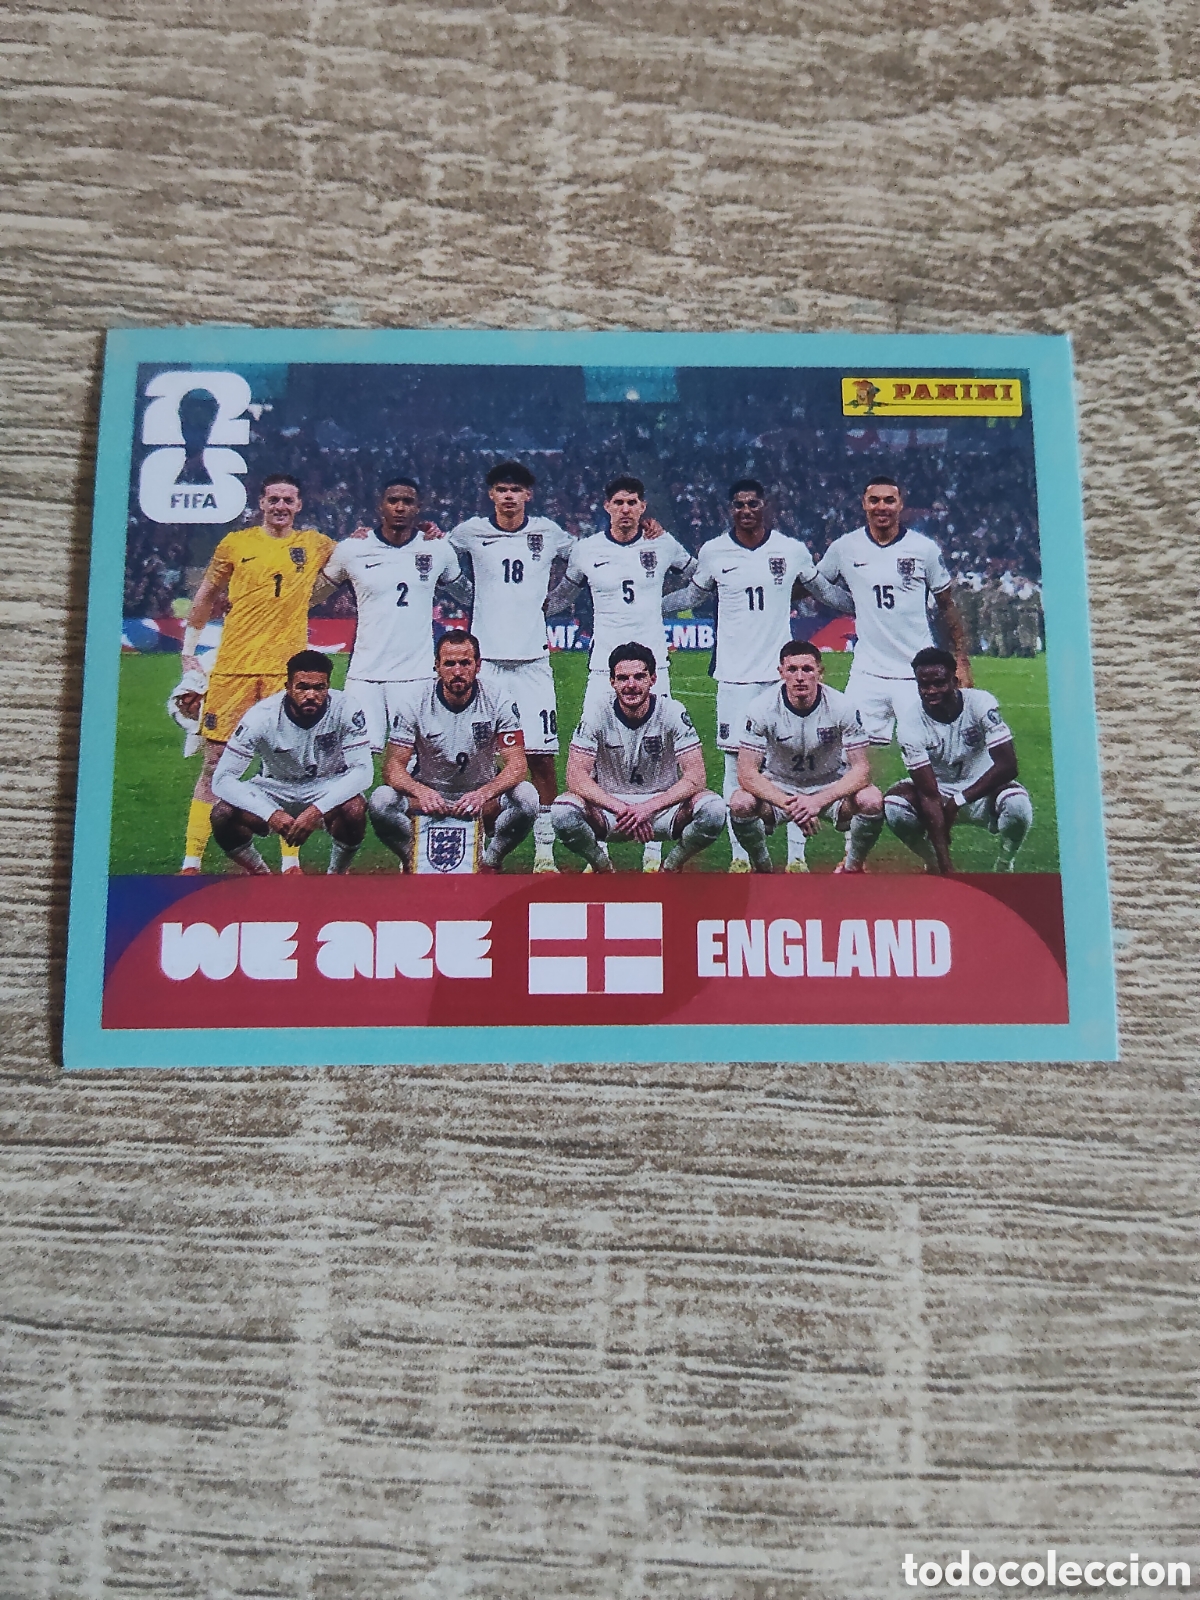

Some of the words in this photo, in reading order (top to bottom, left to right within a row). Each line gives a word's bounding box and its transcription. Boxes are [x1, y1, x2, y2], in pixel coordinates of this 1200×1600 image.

[892, 383, 1014, 401] PANINI
[170, 493, 218, 509] FIFA
[502, 558, 525, 584] 18
[273, 573, 284, 598] 1
[396, 582, 409, 607] 2
[622, 579, 635, 605] 5
[872, 584, 895, 610] 15
[744, 586, 764, 612] 11
[503, 732, 516, 746] C
[456, 751, 469, 773] 9
[792, 754, 816, 772] 21
[161, 921, 299, 981] WE
[316, 920, 493, 980] ARE
[696, 918, 952, 978] ENGLAND
